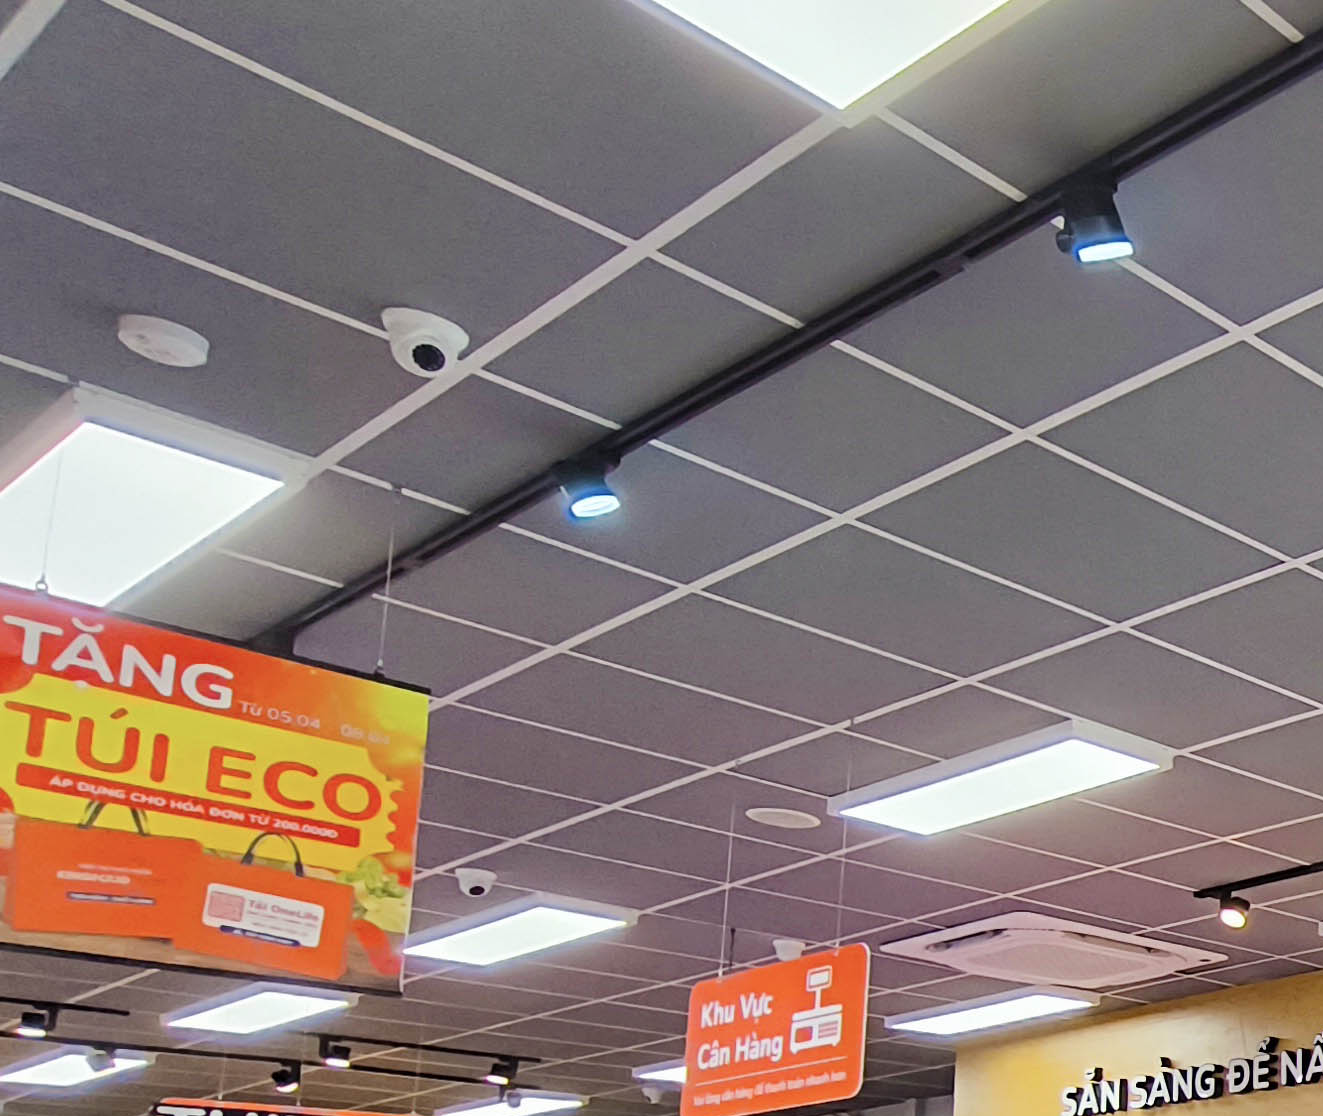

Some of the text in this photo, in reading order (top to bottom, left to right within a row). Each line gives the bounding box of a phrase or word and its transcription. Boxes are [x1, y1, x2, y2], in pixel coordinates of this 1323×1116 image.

[4, 701, 382, 821] TÚI ECO
[701, 991, 774, 1029] Khu Vực
[697, 1032, 784, 1070] Cân Hàng
